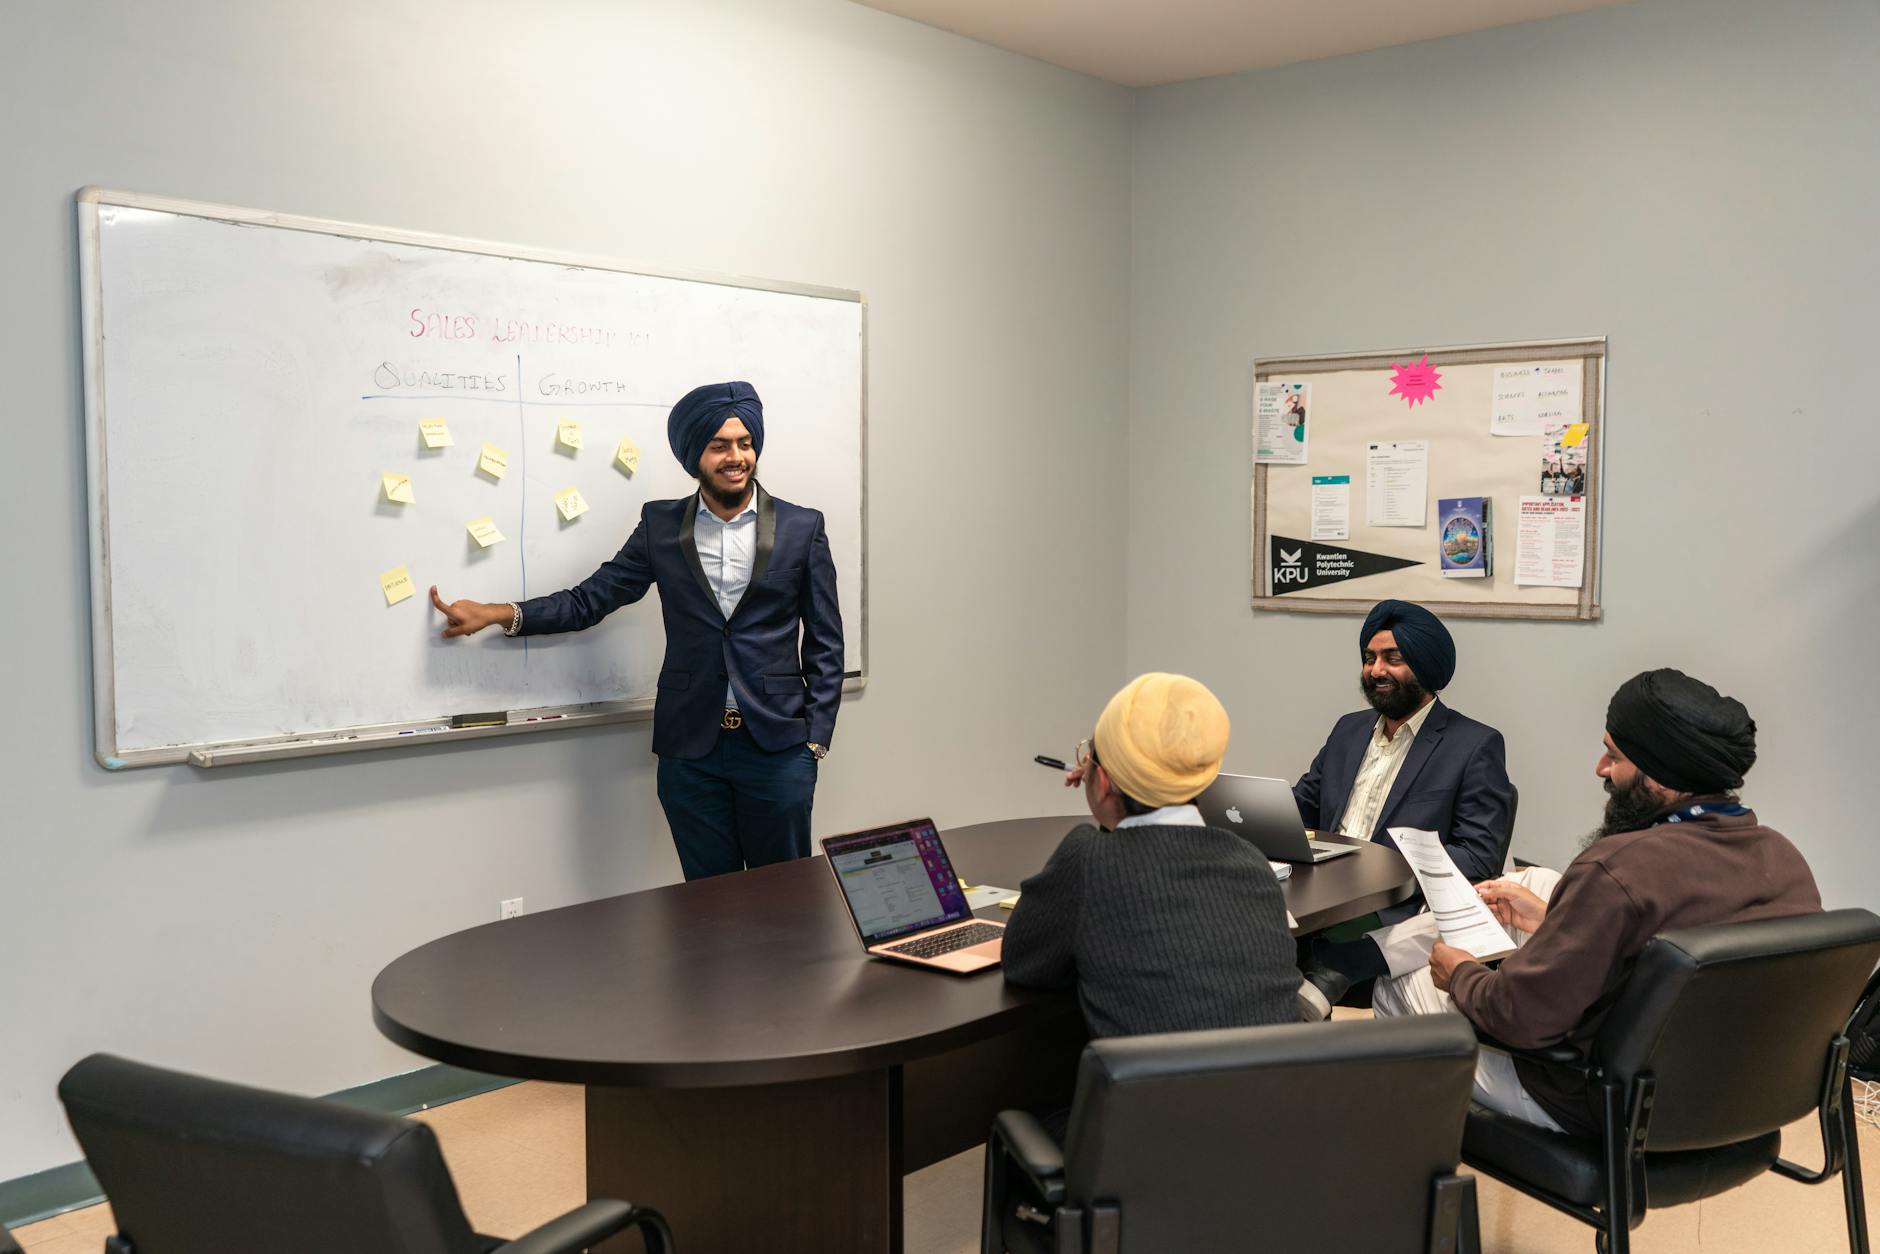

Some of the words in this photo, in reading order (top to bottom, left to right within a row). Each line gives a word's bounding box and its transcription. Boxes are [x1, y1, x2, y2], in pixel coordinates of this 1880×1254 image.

[409, 308, 477, 340] SALES
[374, 361, 507, 392] QUALITIES
[537, 373, 628, 396] GROWTH
[1316, 552, 1348, 560] Kwantlen
[1316, 560, 1355, 570] Polytechnic
[1273, 567, 1309, 583] KPU
[1316, 568, 1351, 577] University
